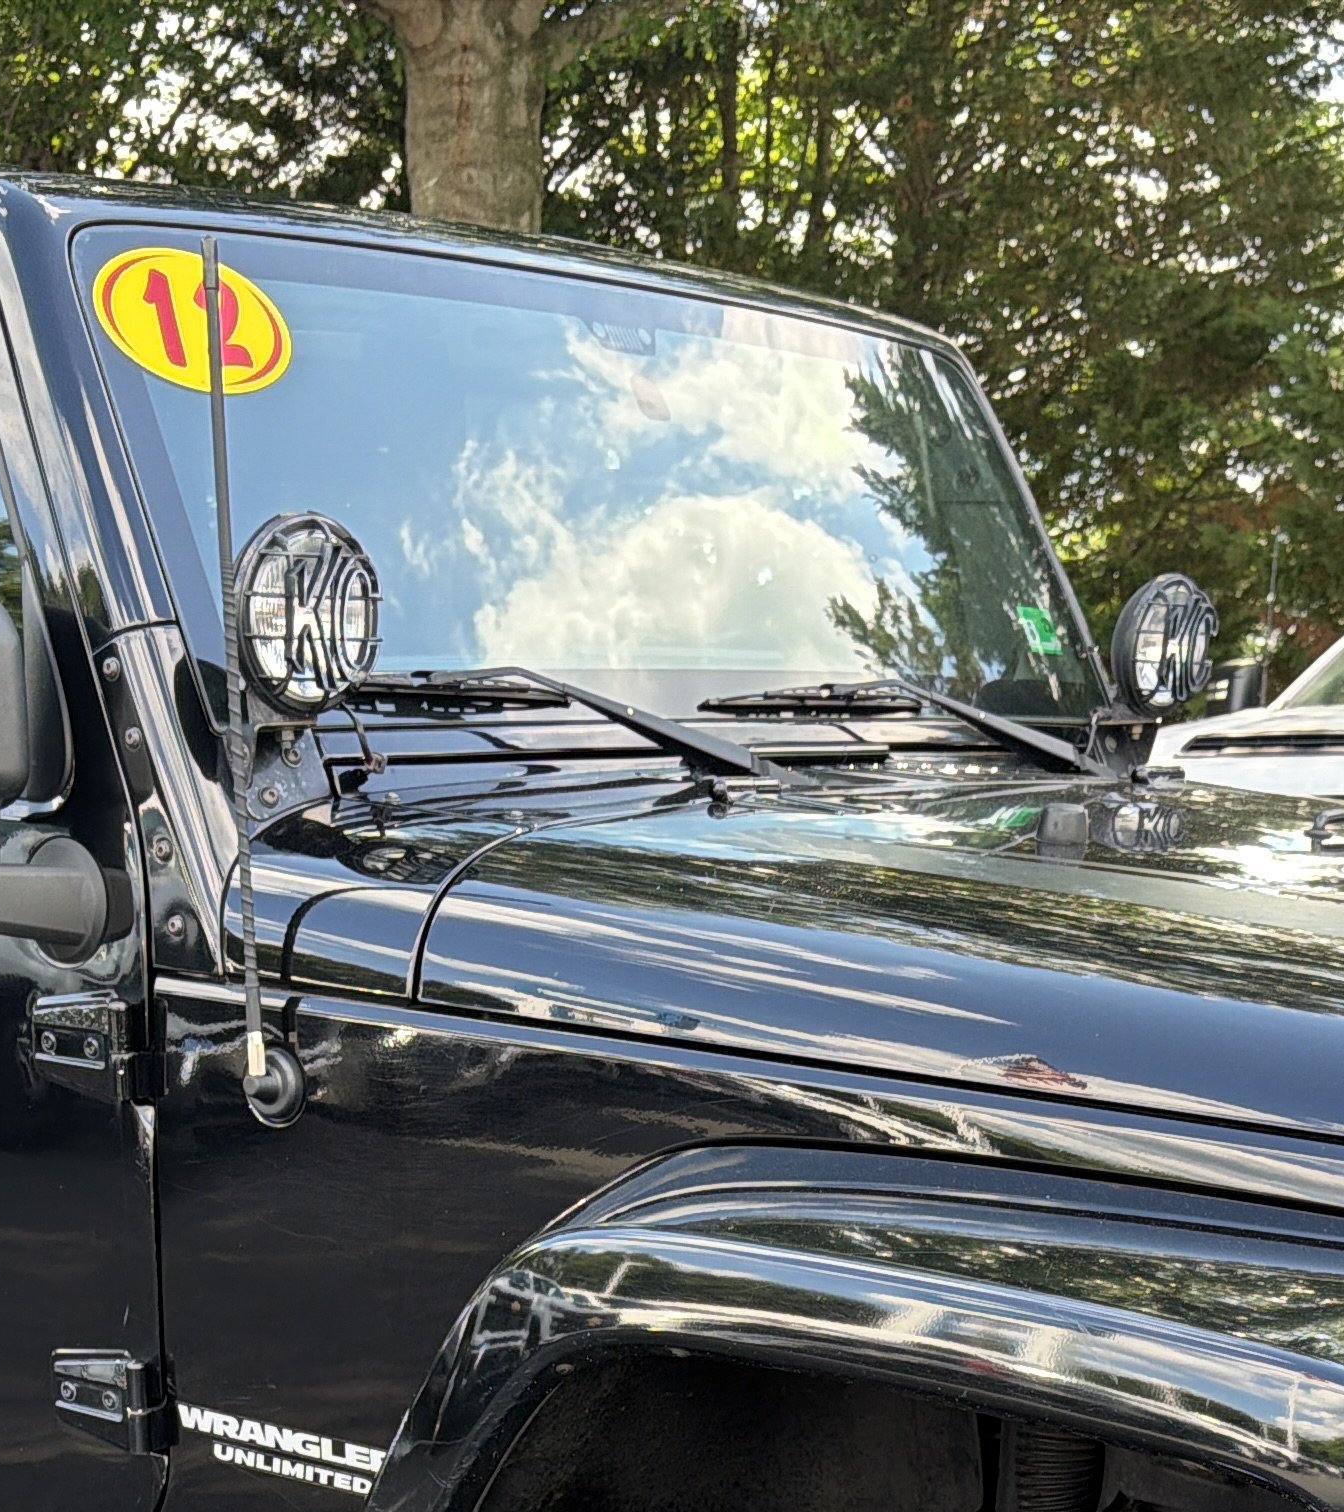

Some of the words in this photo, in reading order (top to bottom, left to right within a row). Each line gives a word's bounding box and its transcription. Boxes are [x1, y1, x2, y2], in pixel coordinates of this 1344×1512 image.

[142, 268, 255, 369] 12
[284, 541, 383, 694] KC
[1156, 594, 1219, 702] KC
[213, 1443, 373, 1495] UNLIMITED
